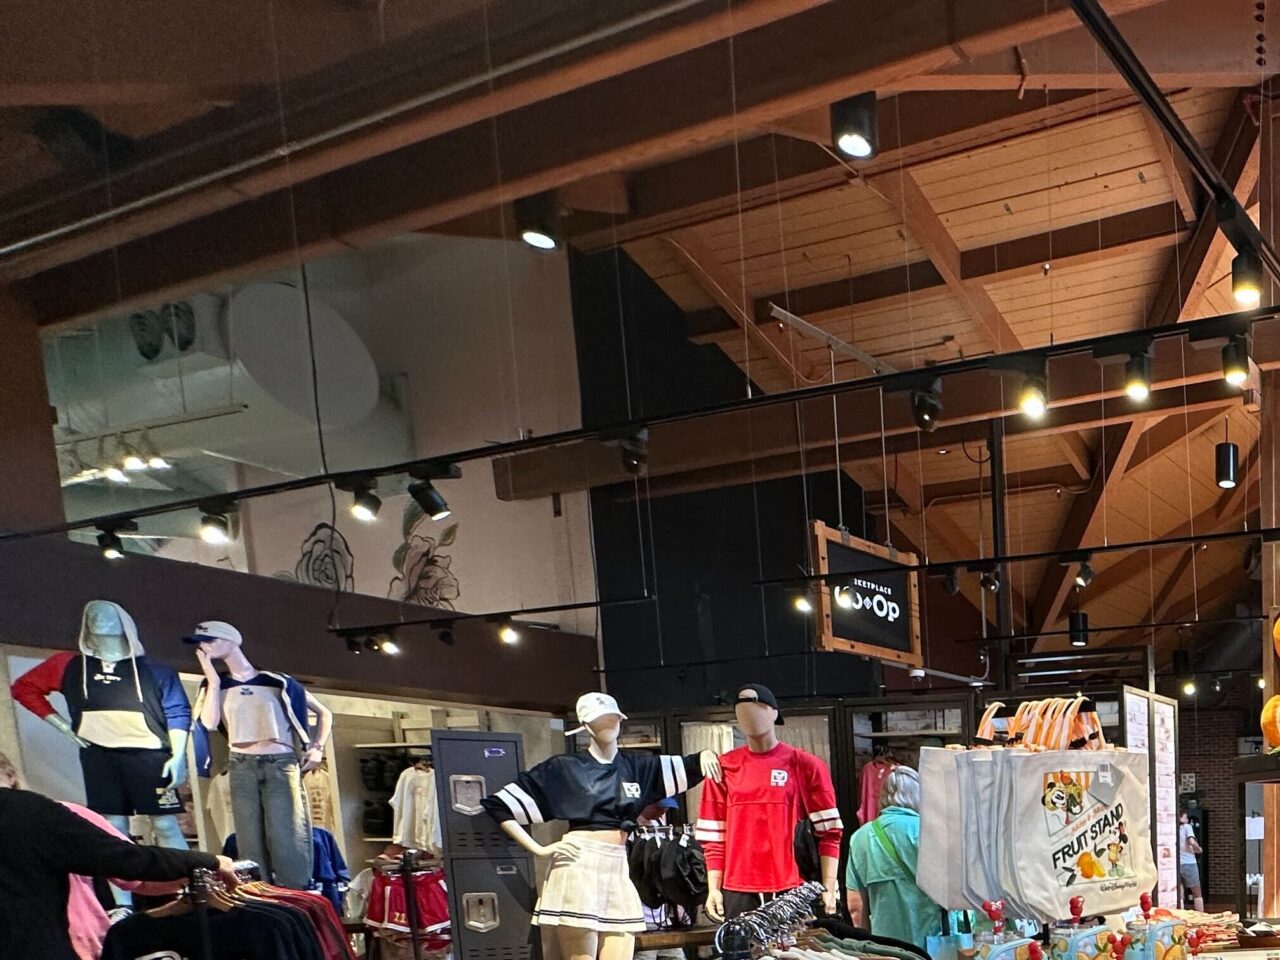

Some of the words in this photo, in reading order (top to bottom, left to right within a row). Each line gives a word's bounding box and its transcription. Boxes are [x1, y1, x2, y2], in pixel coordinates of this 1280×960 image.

[853, 577, 892, 595] KETPLACE
[1052, 829, 1089, 870] FRUIT
[1090, 803, 1124, 841] STAND
